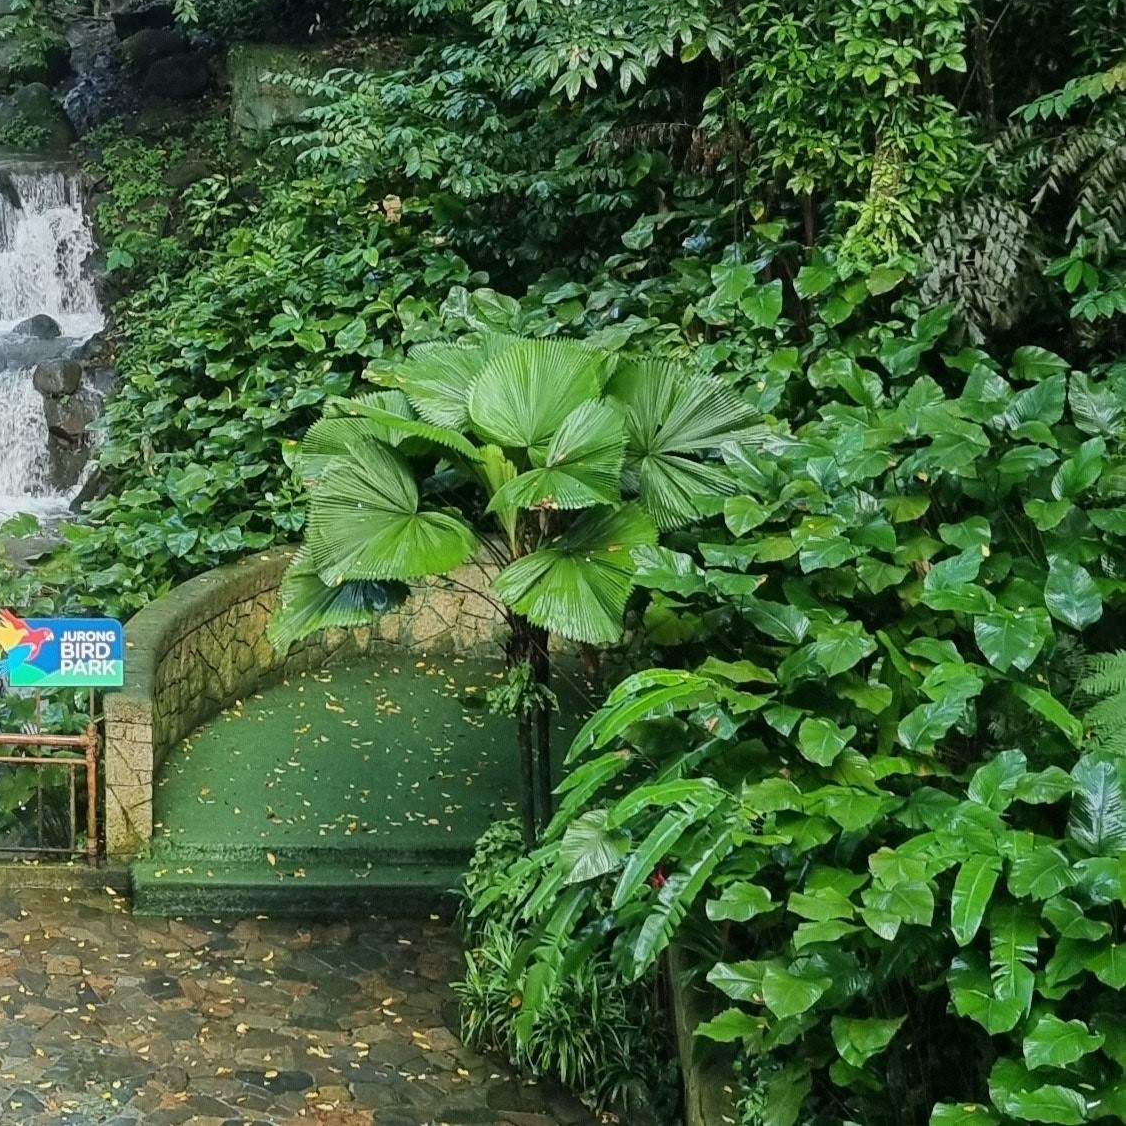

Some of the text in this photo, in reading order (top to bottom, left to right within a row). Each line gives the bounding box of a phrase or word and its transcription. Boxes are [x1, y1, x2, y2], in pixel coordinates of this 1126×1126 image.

[60, 631, 116, 642] JURONG
[60, 643, 111, 659] BIRD
[60, 659, 116, 675] PARK
